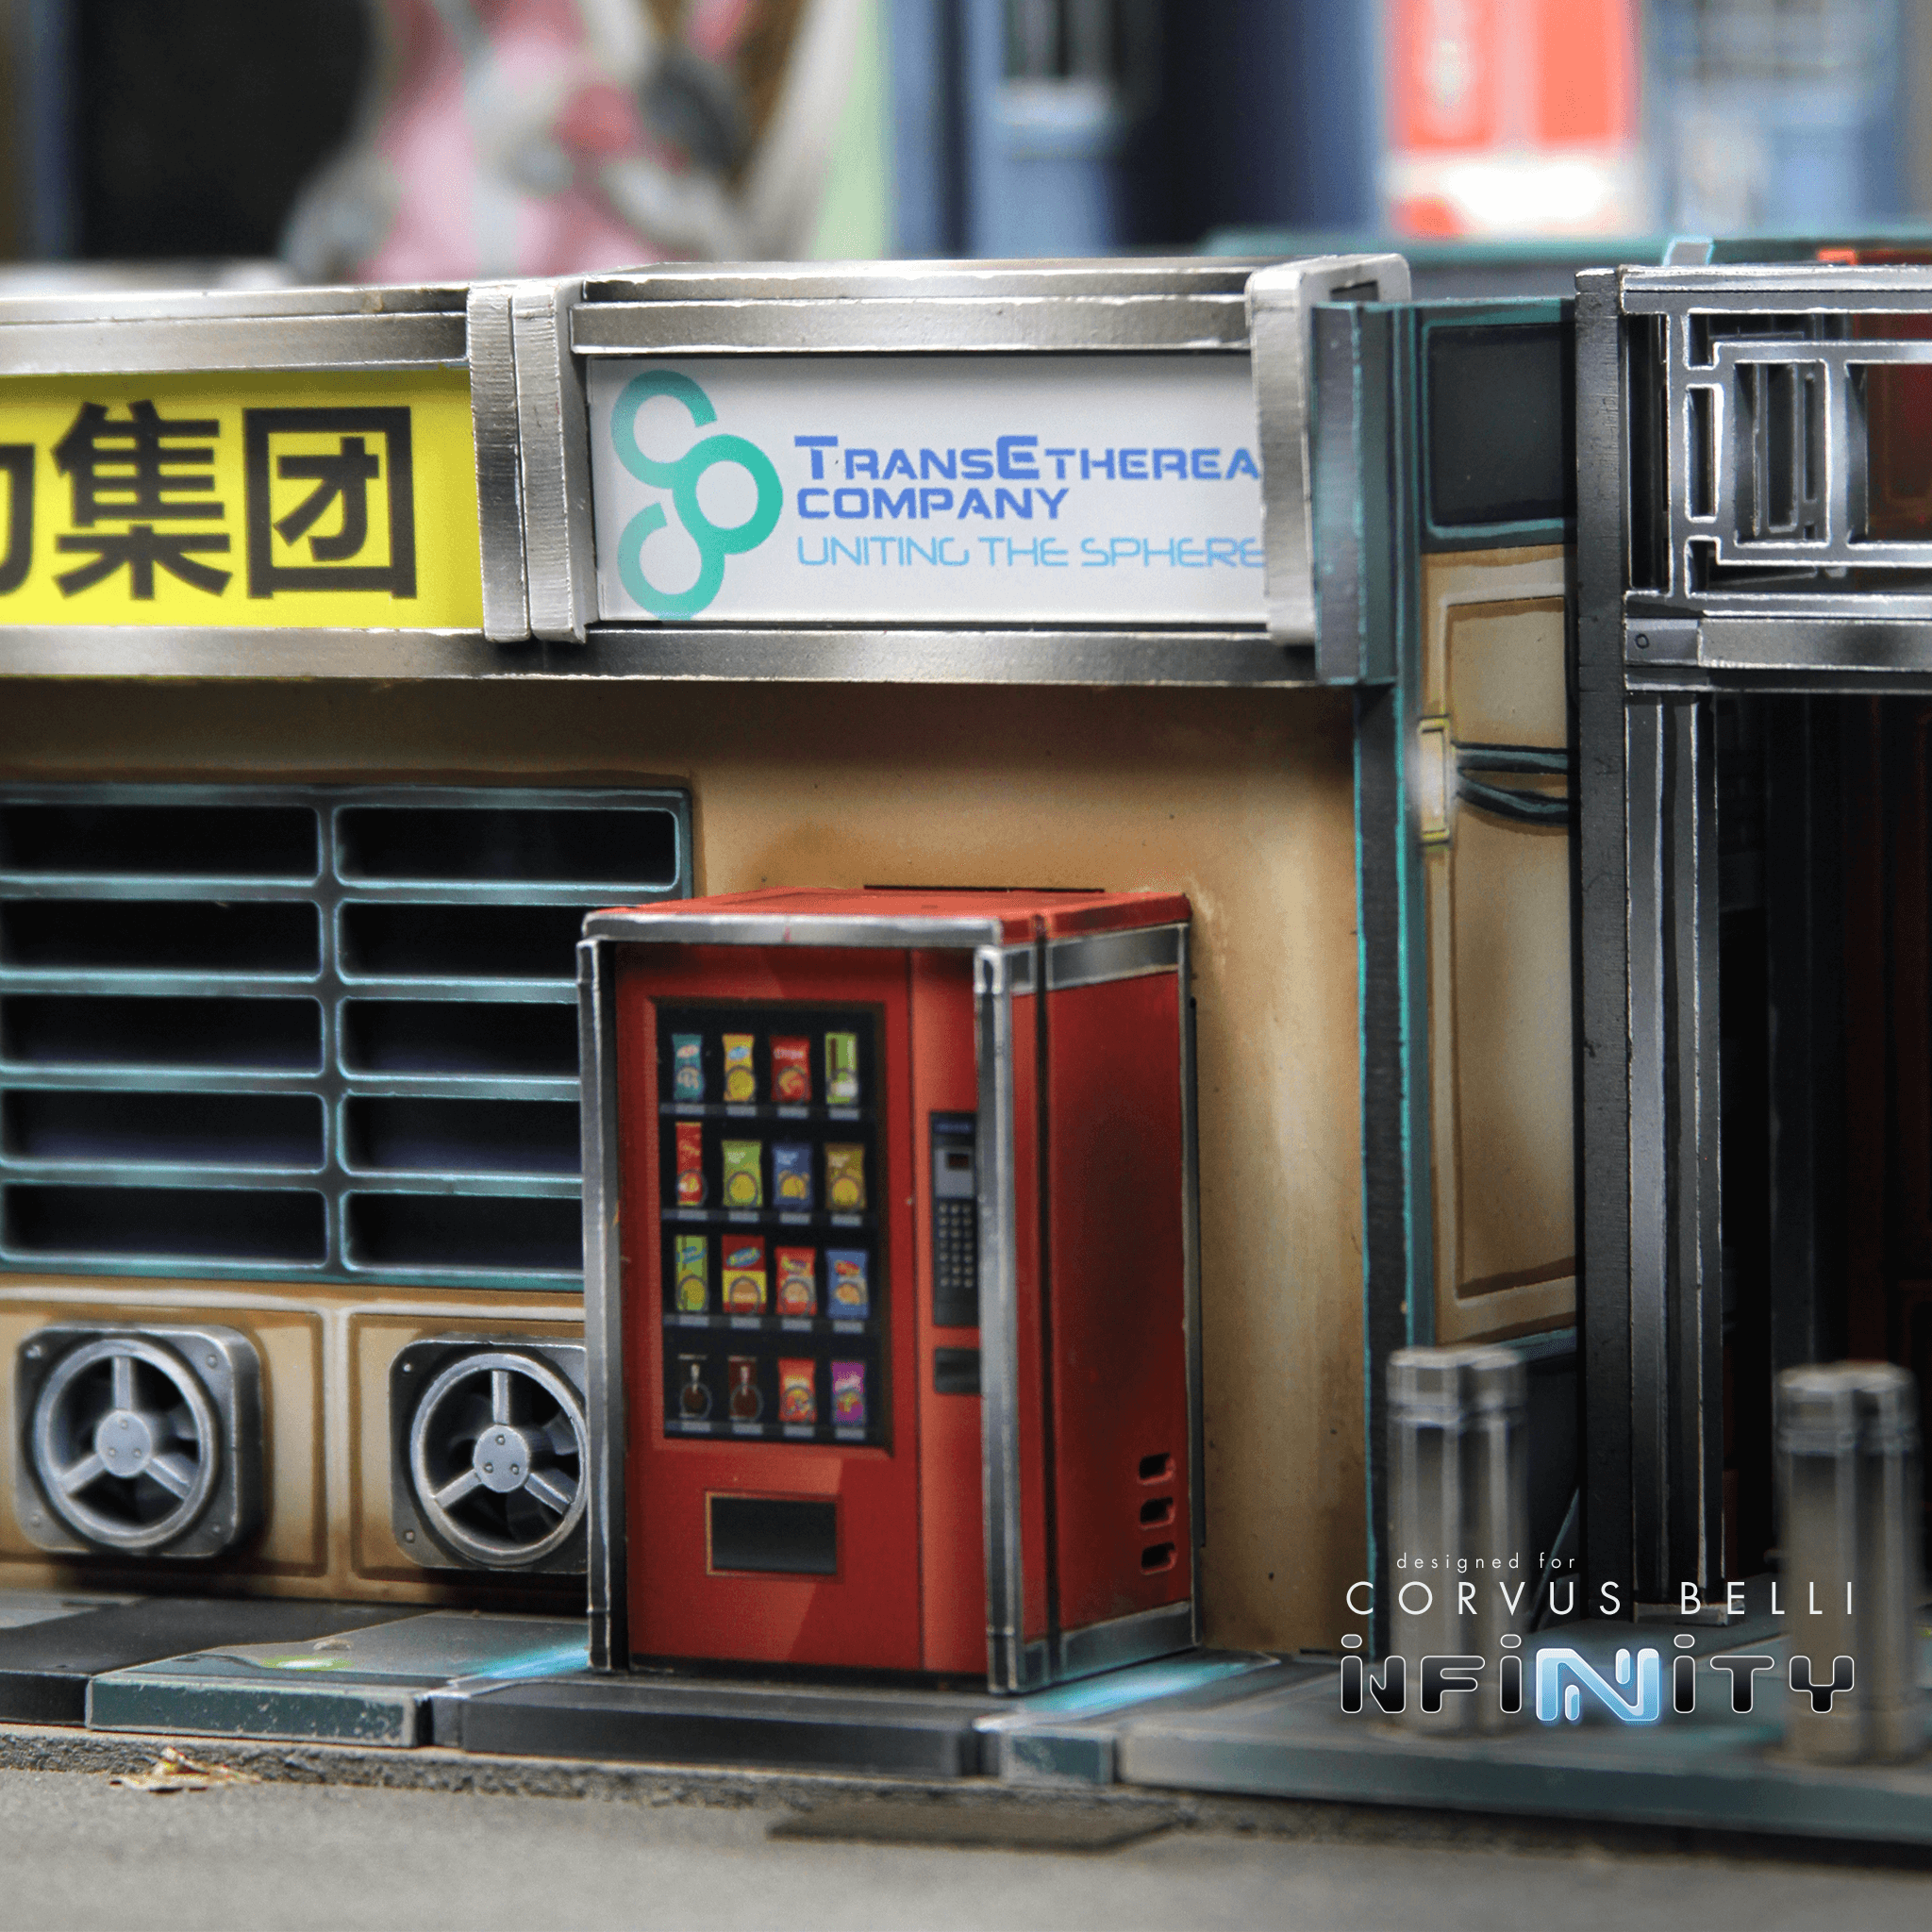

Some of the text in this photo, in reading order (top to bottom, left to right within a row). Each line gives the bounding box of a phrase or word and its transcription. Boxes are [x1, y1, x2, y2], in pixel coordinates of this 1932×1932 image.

[797, 487, 1069, 521] COMPANY
[796, 535, 971, 568] UNITING
[978, 537, 1069, 568] THE
